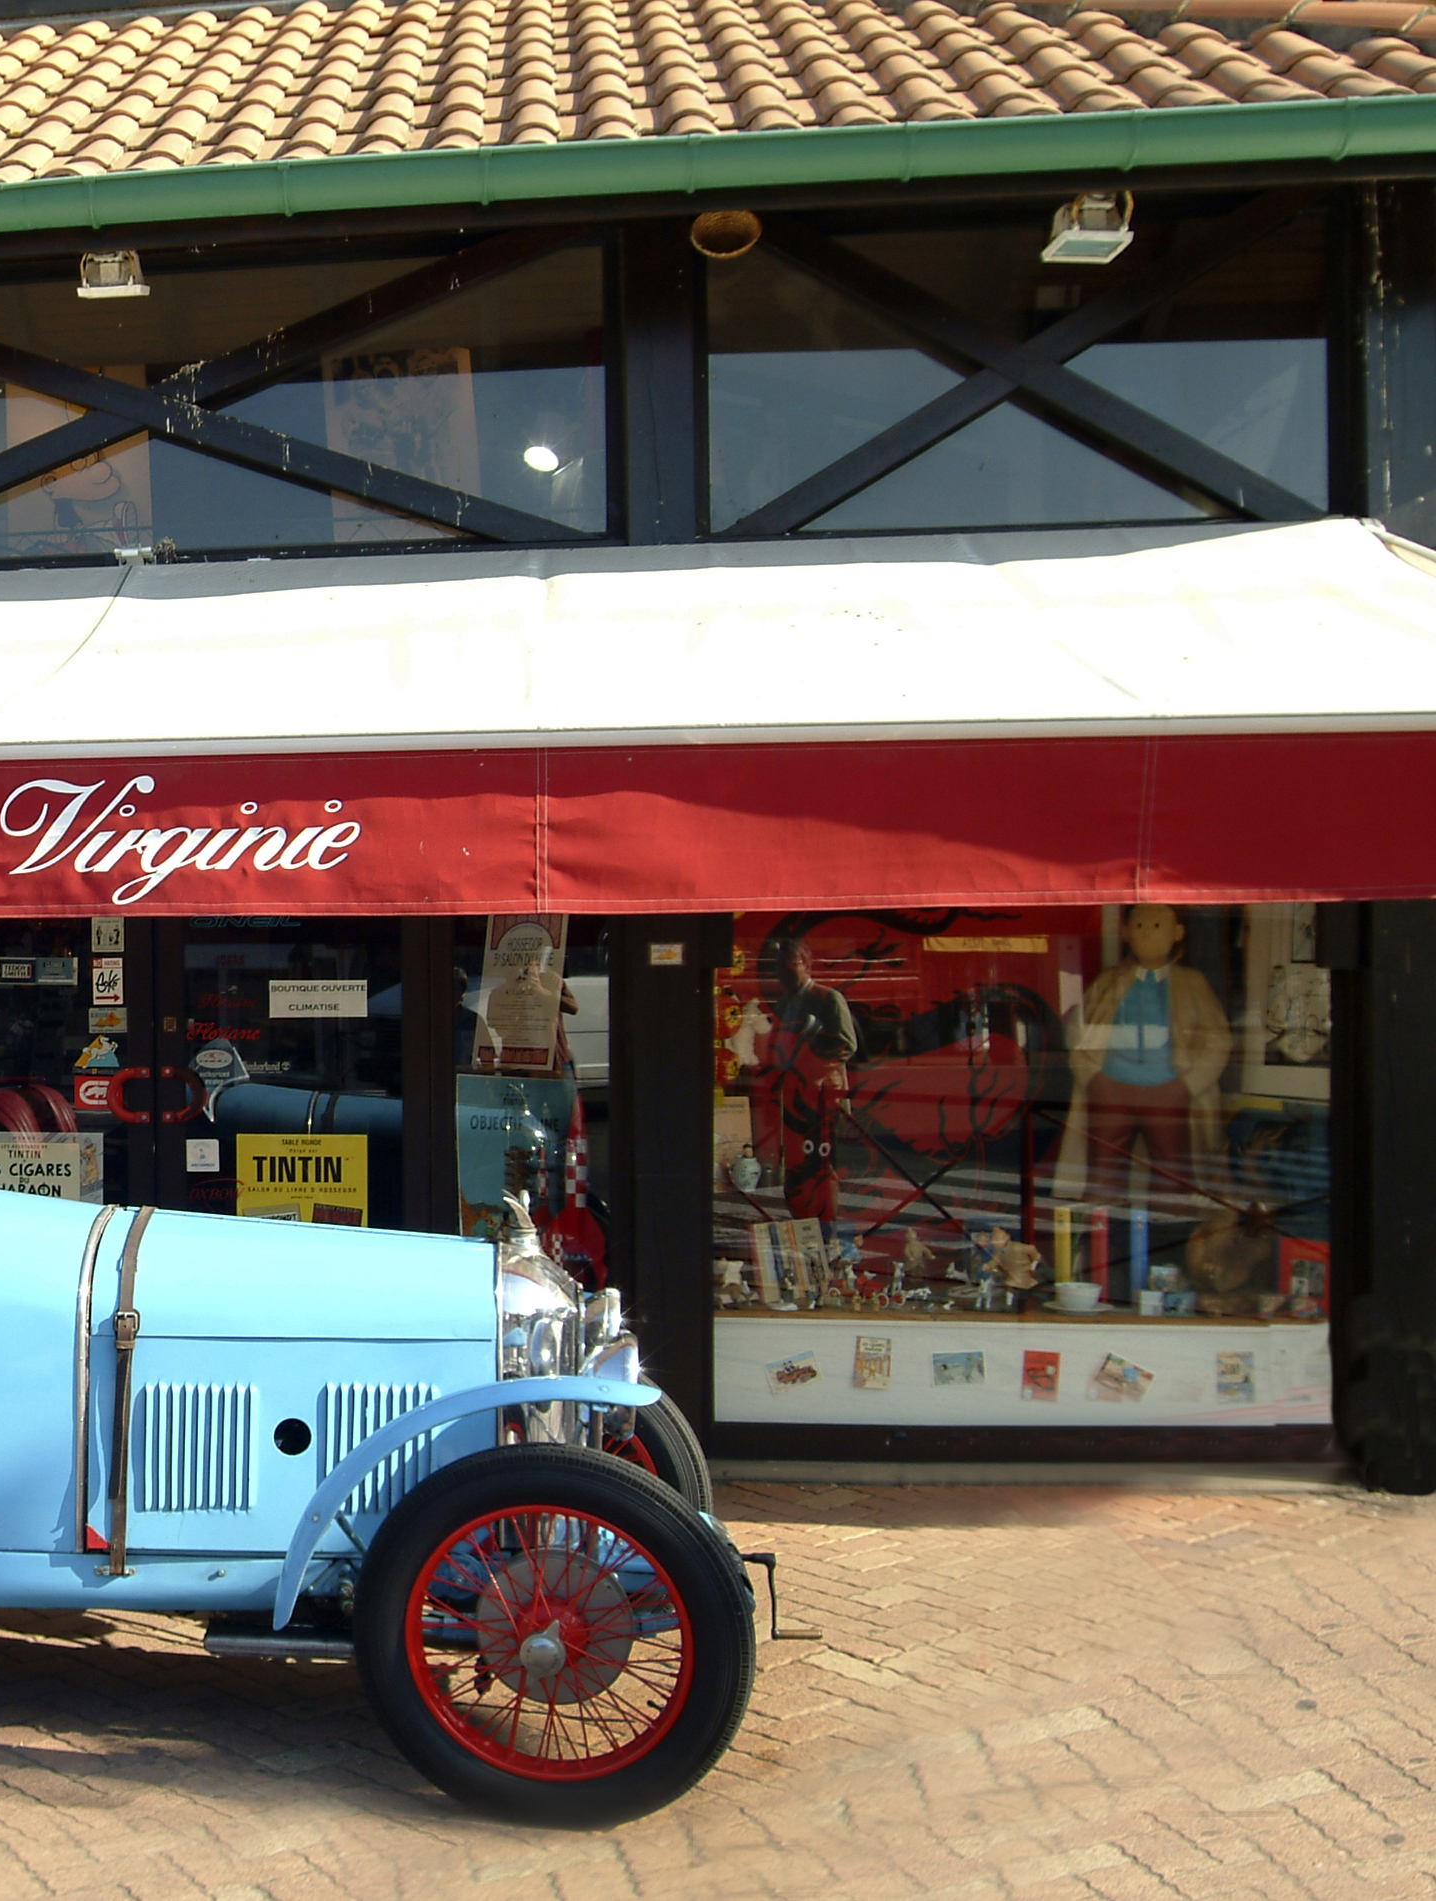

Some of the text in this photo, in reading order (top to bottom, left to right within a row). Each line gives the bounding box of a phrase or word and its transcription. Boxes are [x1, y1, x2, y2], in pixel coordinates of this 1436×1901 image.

[0, 775, 361, 905] Virginie
[321, 984, 366, 992] OUVERTE
[288, 1003, 340, 1011] CLIMATISE
[186, 1022, 261, 1040] Floriane
[470, 1114, 523, 1131] OBJECTIF
[8, 1150, 41, 1158] TINTIN
[9, 1163, 72, 1176] CIGARES
[252, 1156, 342, 1183] TINTIN
